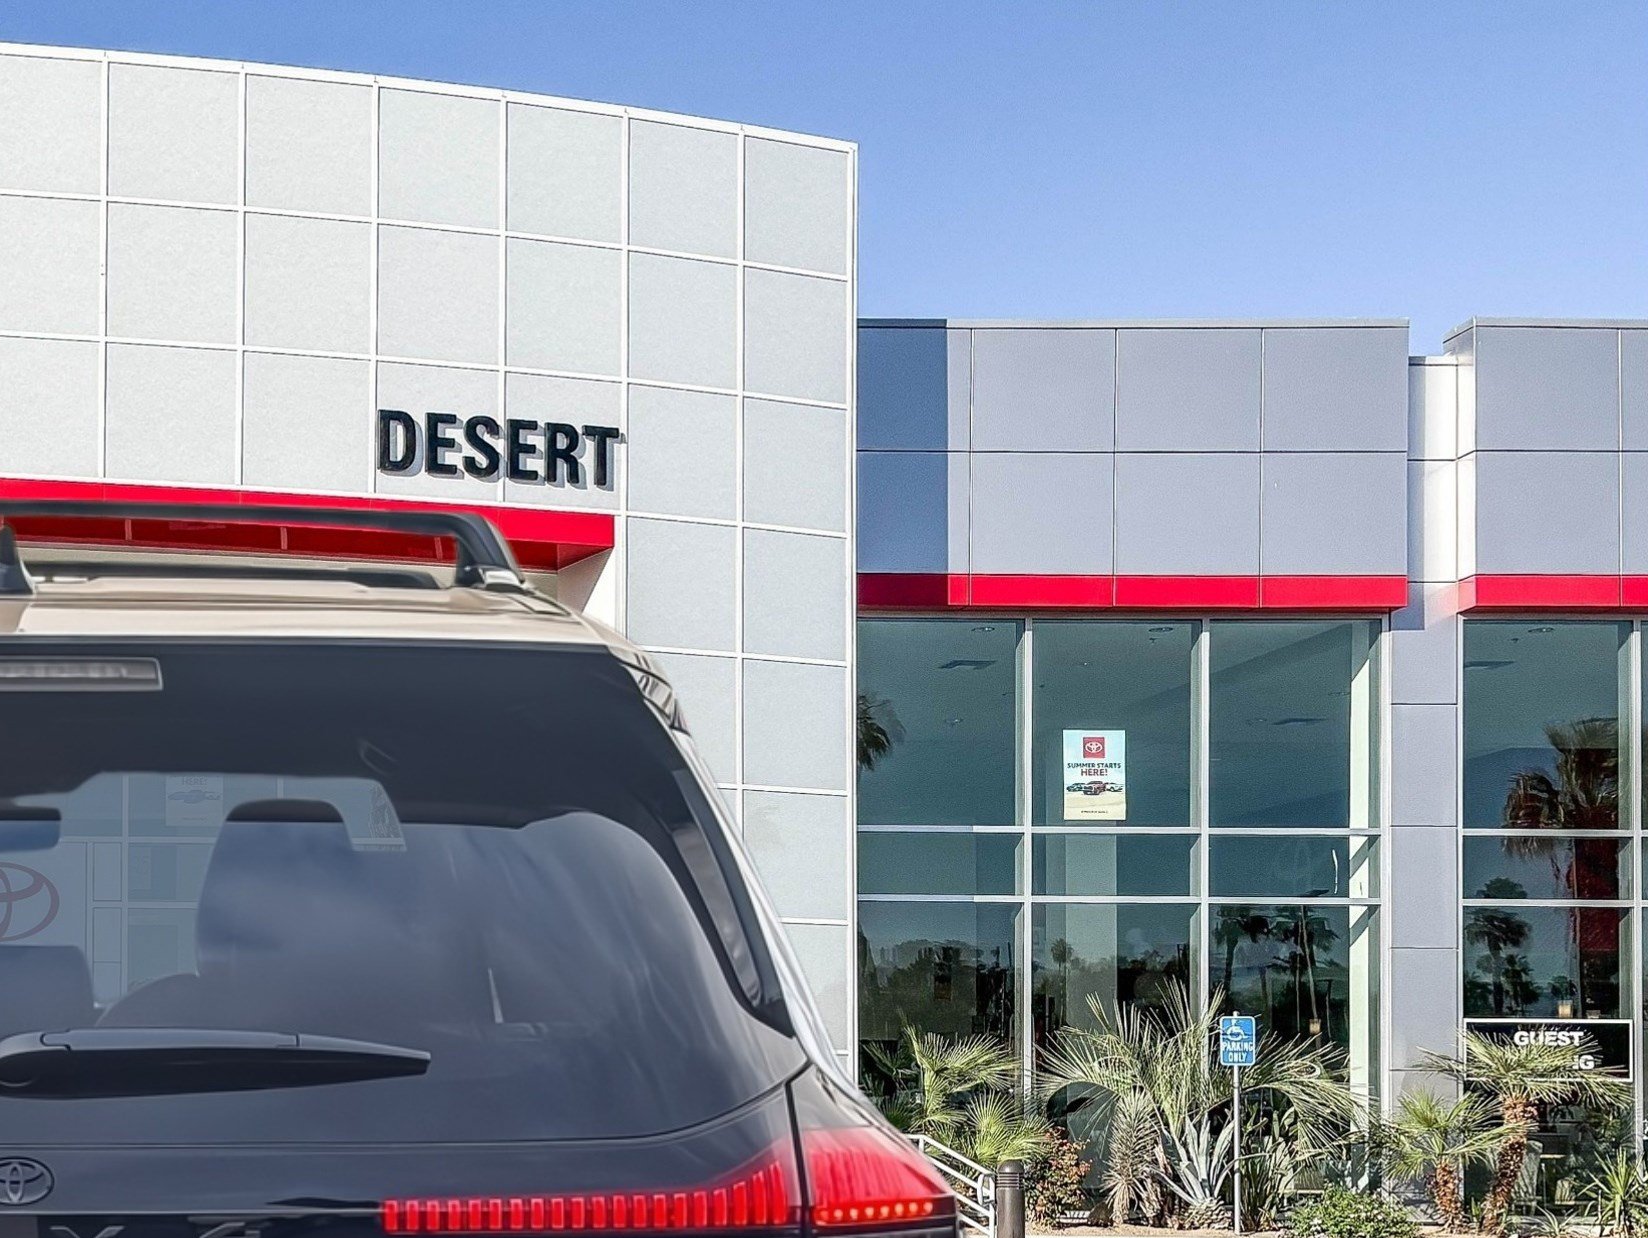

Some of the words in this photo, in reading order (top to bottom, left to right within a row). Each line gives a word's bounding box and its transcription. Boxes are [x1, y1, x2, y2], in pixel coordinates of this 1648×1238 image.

[377, 409, 620, 486] DESERT
[1080, 768, 1108, 776] HERE!
[1513, 1030, 1584, 1046] GUEST
[1222, 1041, 1254, 1051] PARKING
[1228, 1052, 1247, 1062] ONLY
